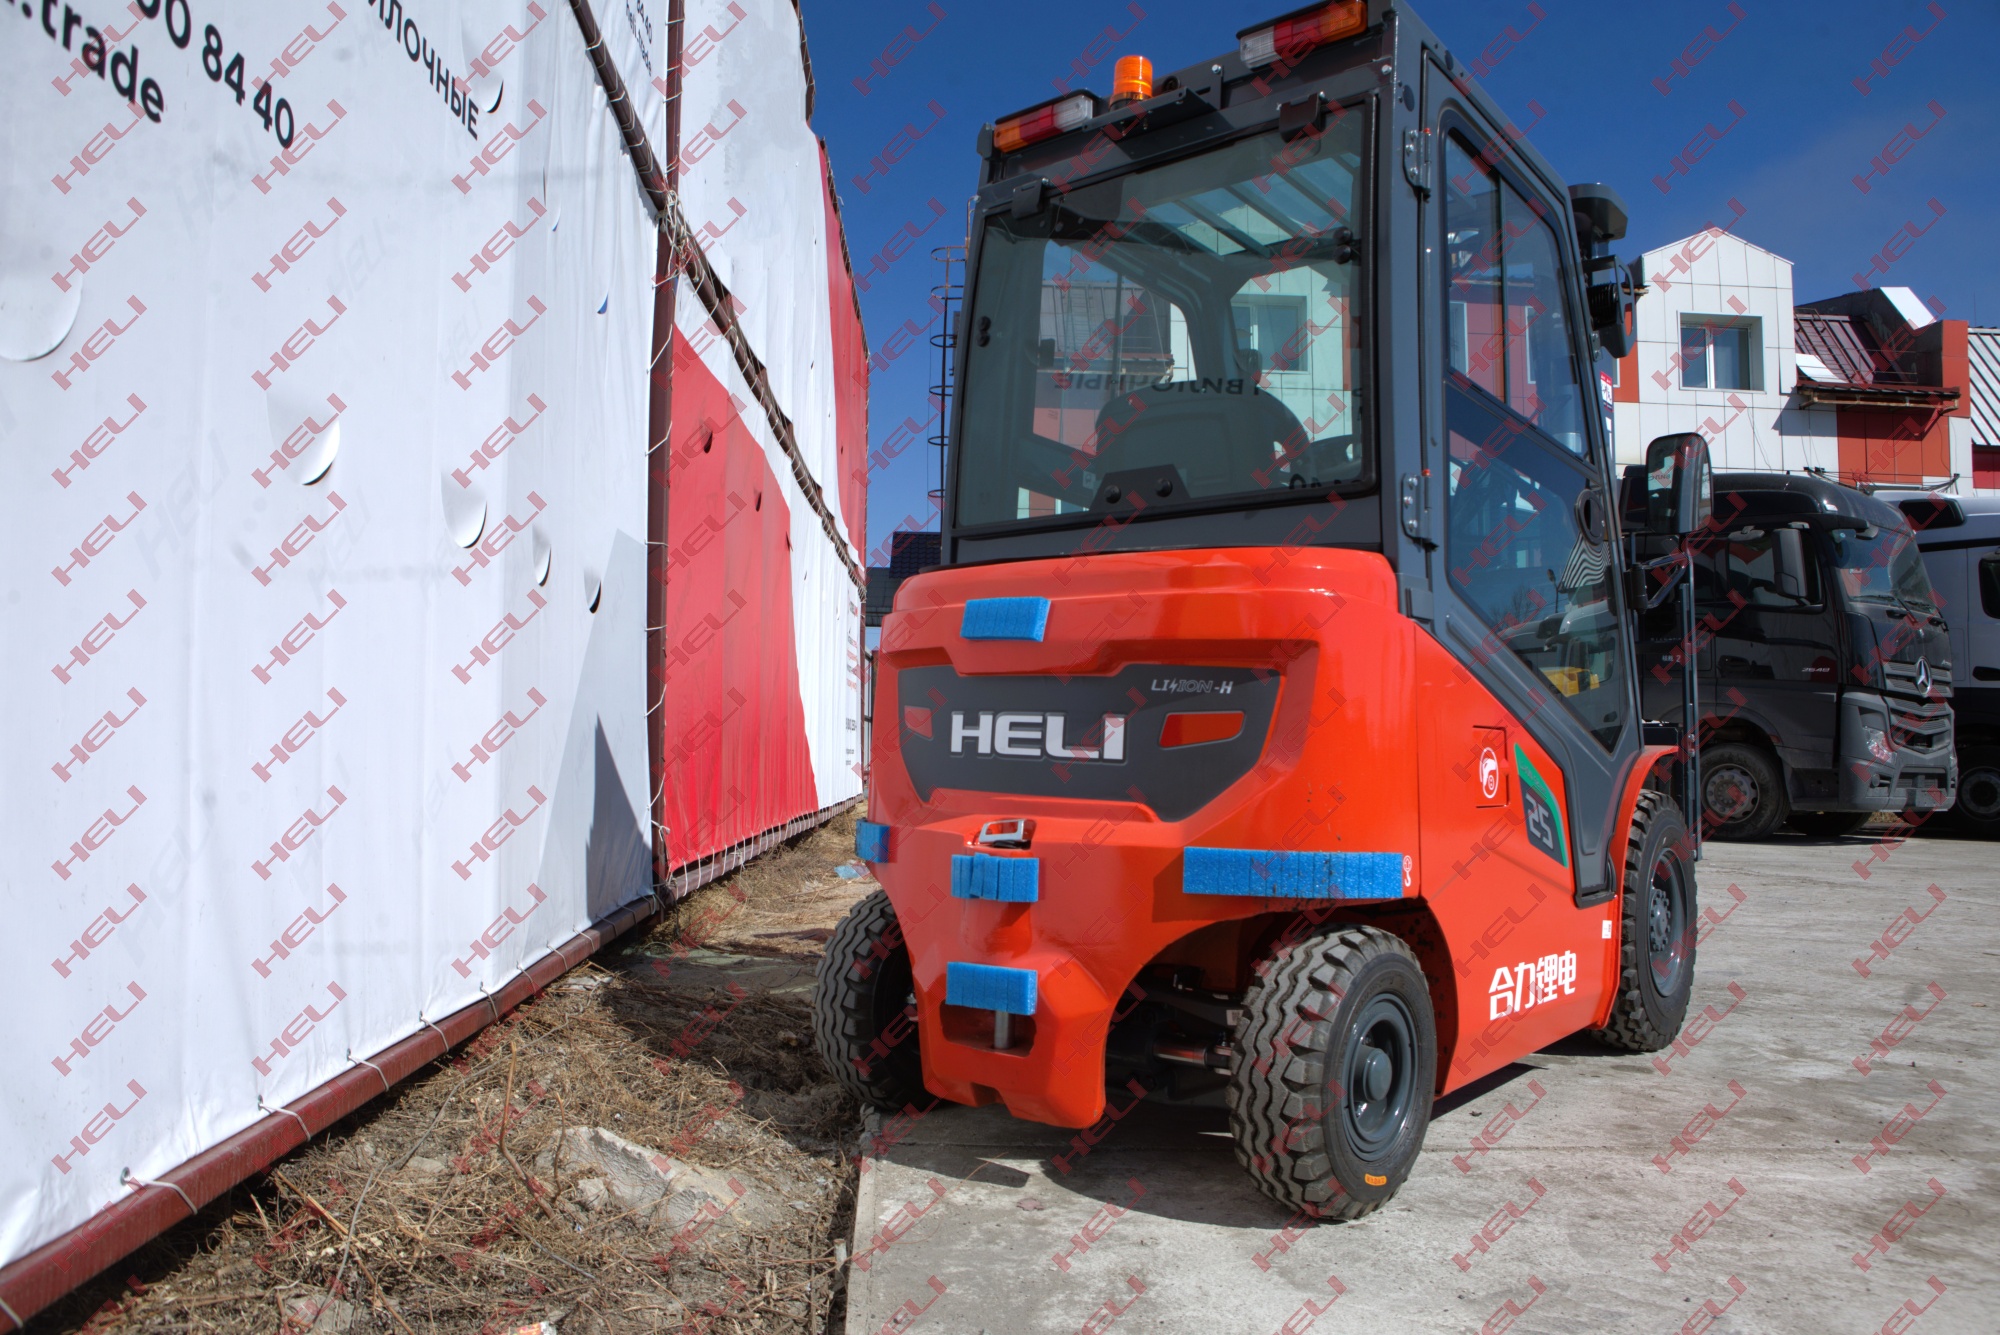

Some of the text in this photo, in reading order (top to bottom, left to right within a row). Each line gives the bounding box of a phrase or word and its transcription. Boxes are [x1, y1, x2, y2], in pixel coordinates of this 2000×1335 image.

[0, 0, 164, 124] .trade
[202, 24, 246, 107] 84
[253, 81, 295, 150] 40
[949, 711, 1128, 764] HELI
[1525, 793, 1554, 850] 25
[1488, 949, 1577, 1021] 合力锂电
